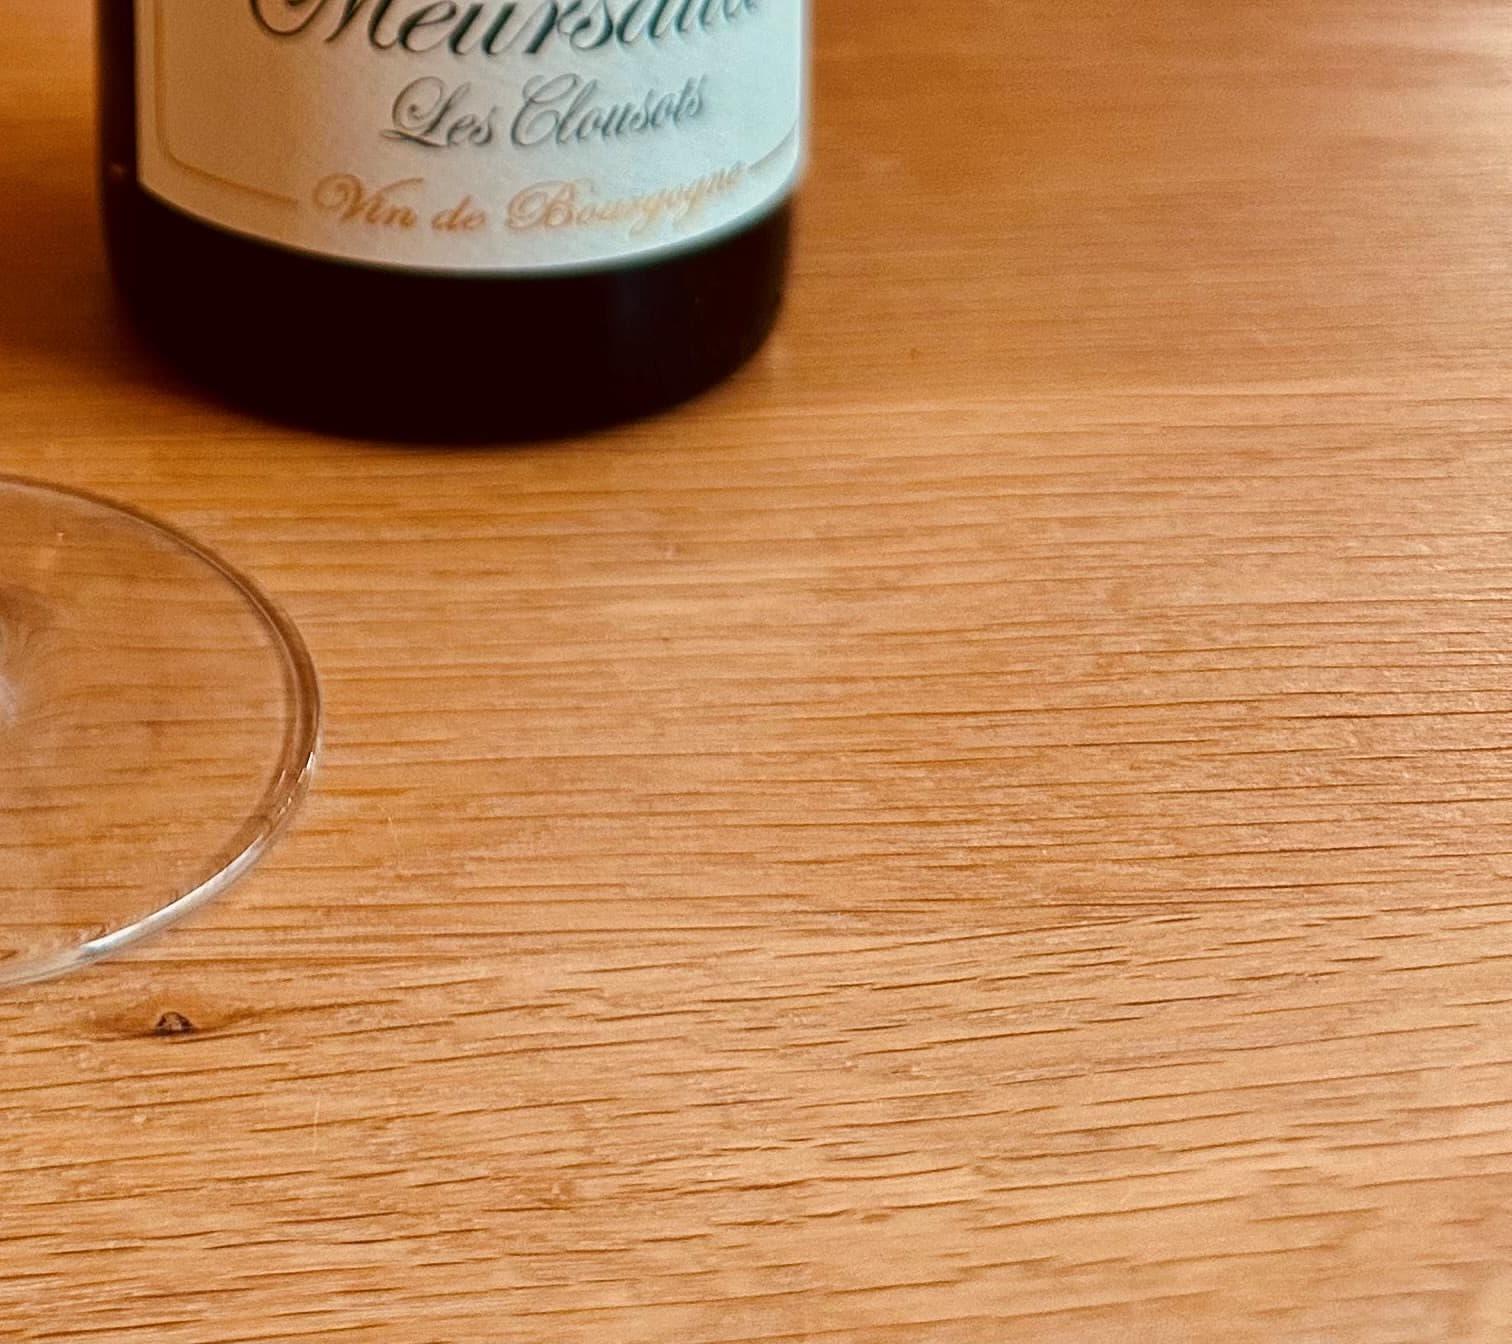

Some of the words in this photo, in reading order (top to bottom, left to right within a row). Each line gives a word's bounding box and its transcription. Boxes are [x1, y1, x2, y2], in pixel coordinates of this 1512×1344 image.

[380, 75, 497, 148] Les
[510, 73, 709, 147] Clousots
[312, 173, 426, 228] Vin
[430, 194, 487, 232] de
[504, 160, 746, 240] Bourgogne
